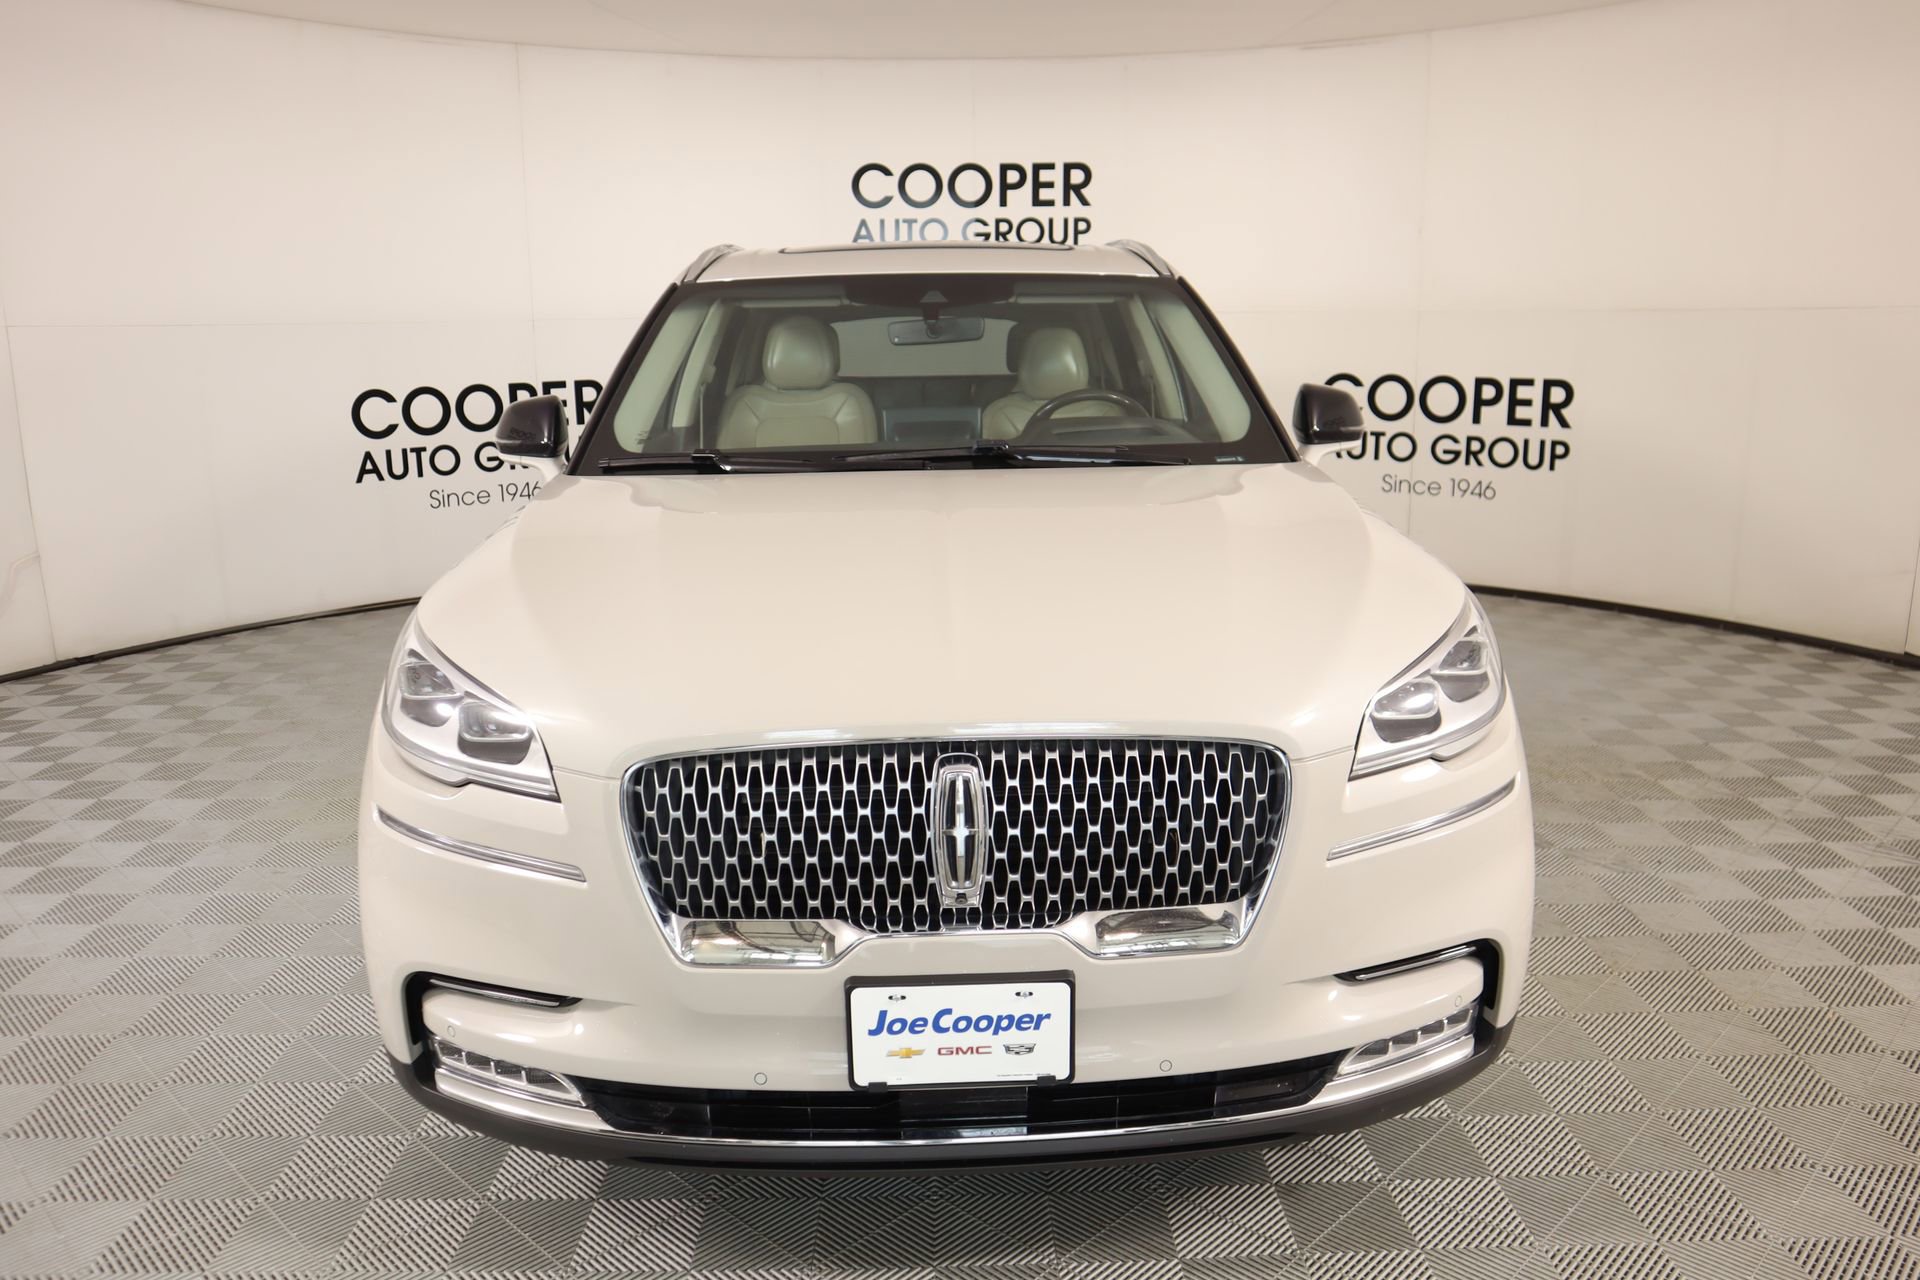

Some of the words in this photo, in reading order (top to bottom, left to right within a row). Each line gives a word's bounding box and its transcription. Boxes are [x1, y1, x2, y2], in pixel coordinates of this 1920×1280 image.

[851, 162, 1093, 209] COOPER
[852, 218, 949, 243] AUTO
[961, 217, 1092, 246] GROUP
[355, 444, 461, 484] AUTO
[1335, 430, 1417, 463] UTO
[1431, 434, 1571, 471] GROUP
[429, 488, 491, 509] Since
[1381, 473, 1443, 497] Since
[1449, 477, 1497, 501] 1946
[937, 1045, 993, 1056] GMC
